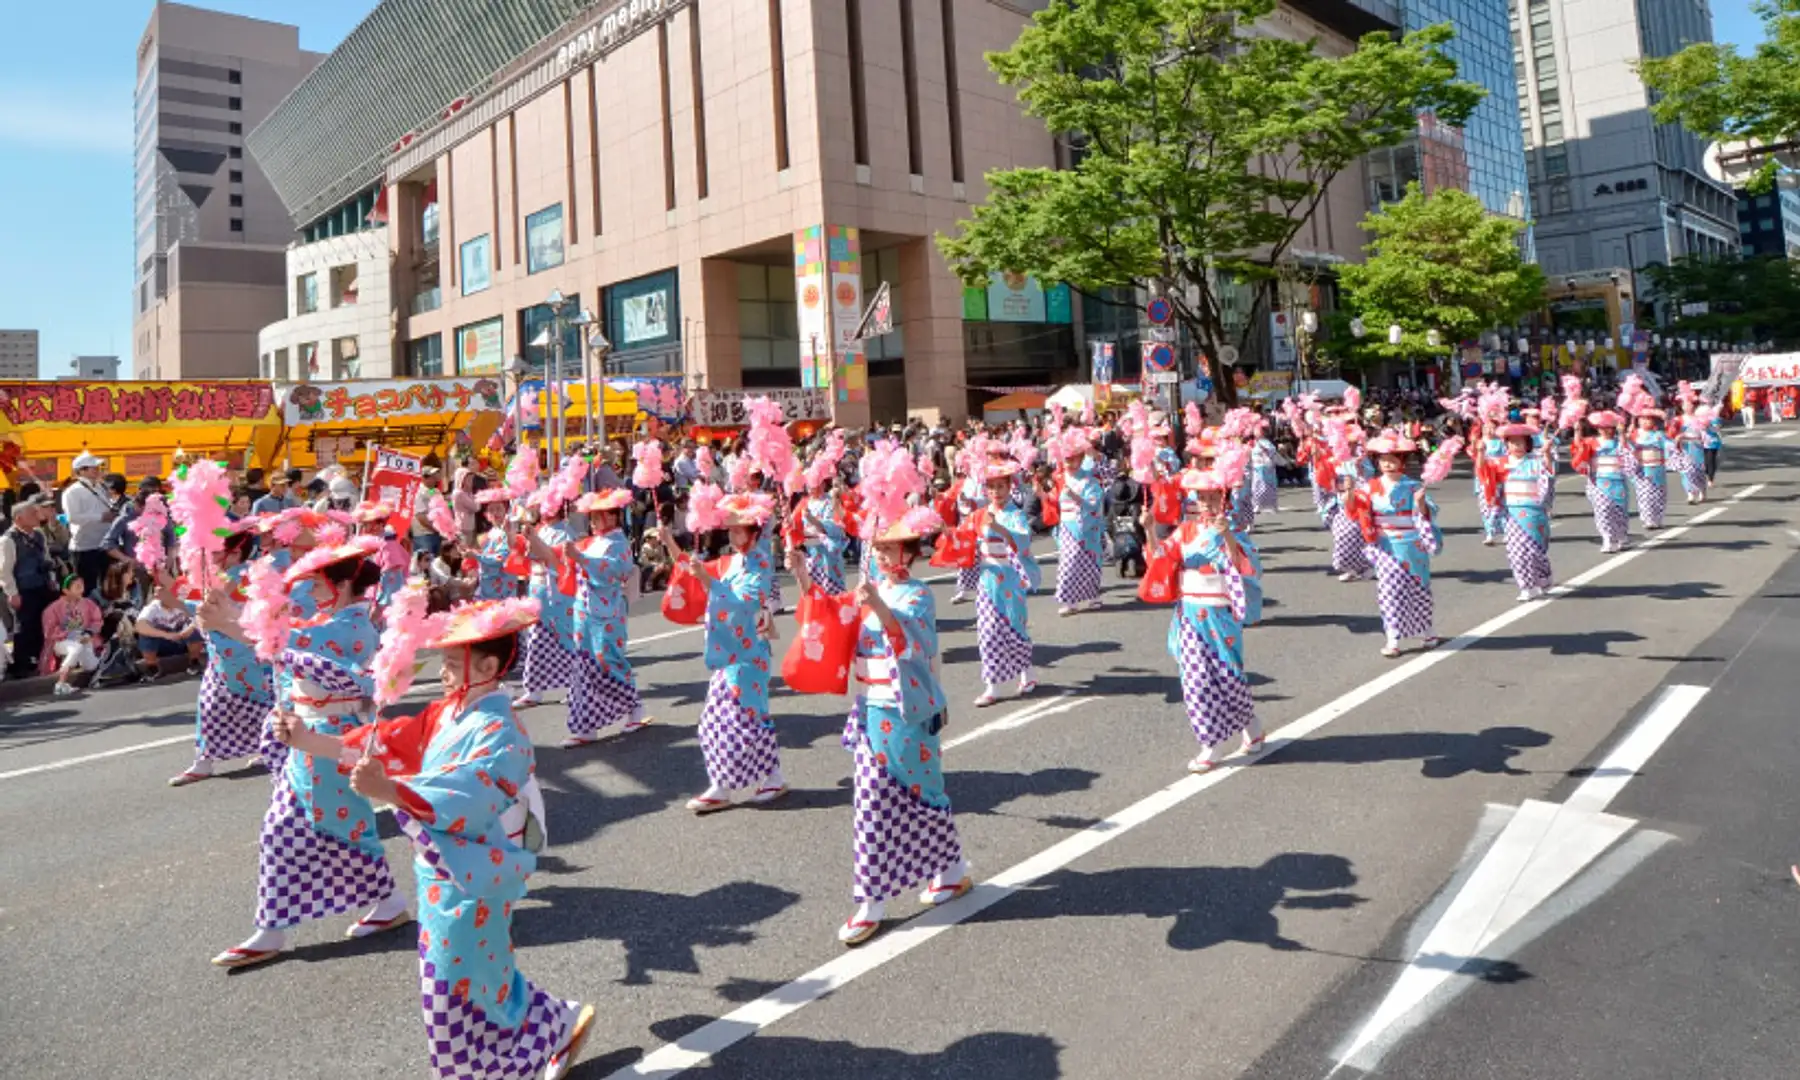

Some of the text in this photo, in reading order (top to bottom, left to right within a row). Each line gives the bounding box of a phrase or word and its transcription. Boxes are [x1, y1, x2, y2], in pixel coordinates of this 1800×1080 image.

[19, 386, 254, 424] 広島風お好み焼き
[324, 382, 475, 418] チョコバナナ
